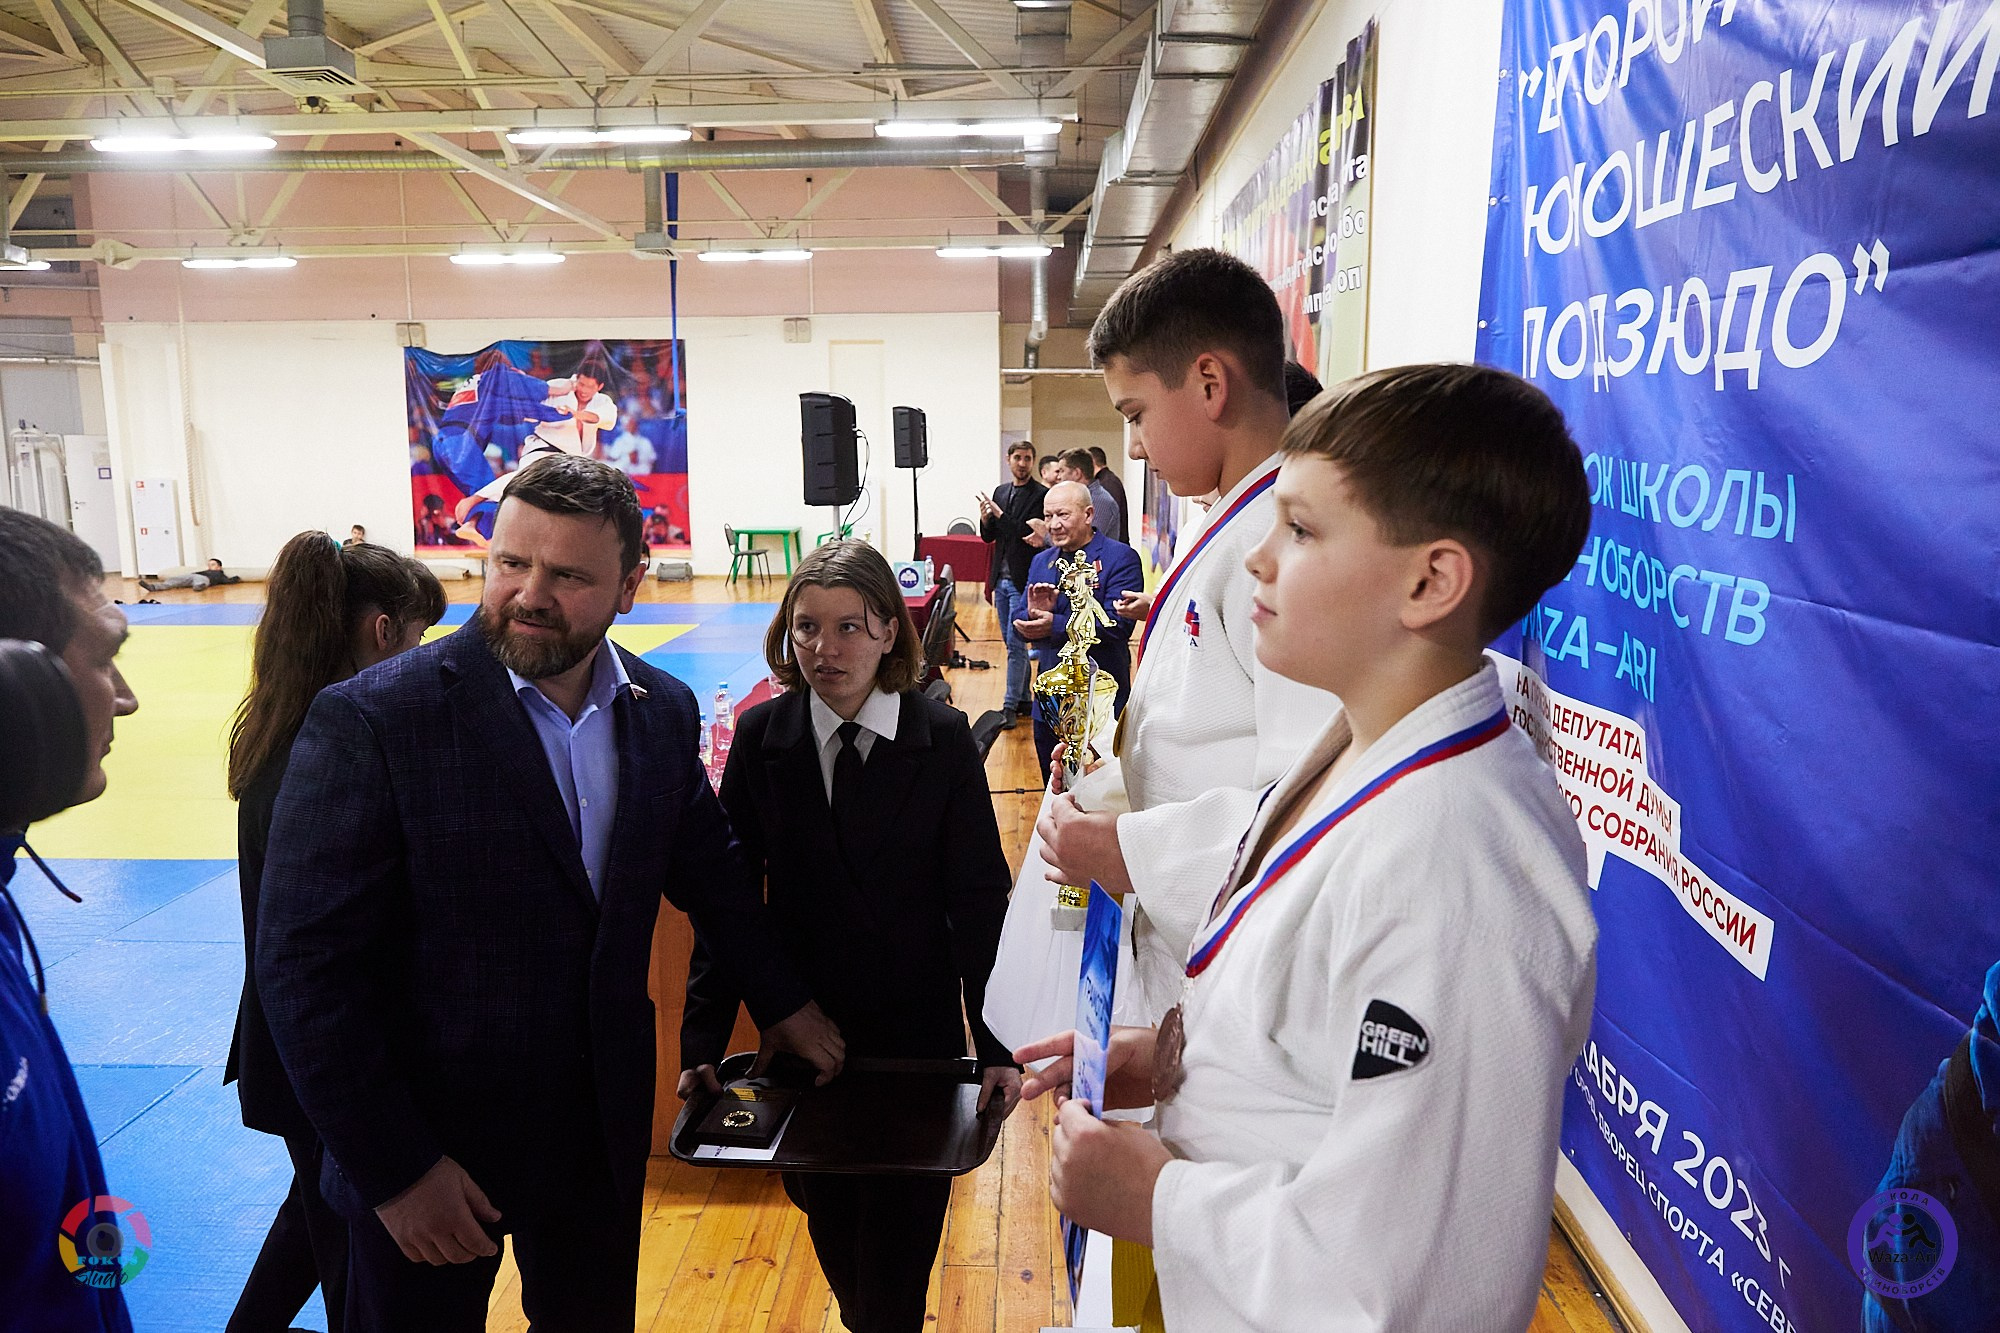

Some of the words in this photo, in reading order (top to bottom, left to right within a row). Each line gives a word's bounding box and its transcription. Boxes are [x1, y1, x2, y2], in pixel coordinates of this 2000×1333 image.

[1619, 459, 1796, 543] ШКОЛЫ
[1563, 536, 1771, 646] НОБОРСТВ
[1553, 704, 1642, 764] ДЕПУТАТА
[1636, 783, 1672, 838] ДУМЫ
[1588, 805, 1680, 887] СОБРАНИЯ
[1681, 866, 1757, 954] РОССИИ
[1360, 1035, 1414, 1067] HILL
[1361, 1020, 1426, 1052] GREEN
[1581, 1041, 1669, 1155] АБРЯ
[1673, 1131, 1771, 1263] 2023
[1598, 1112, 1646, 1195] ДВОРЕЦ
[1648, 1181, 1725, 1277] СПОРТА
